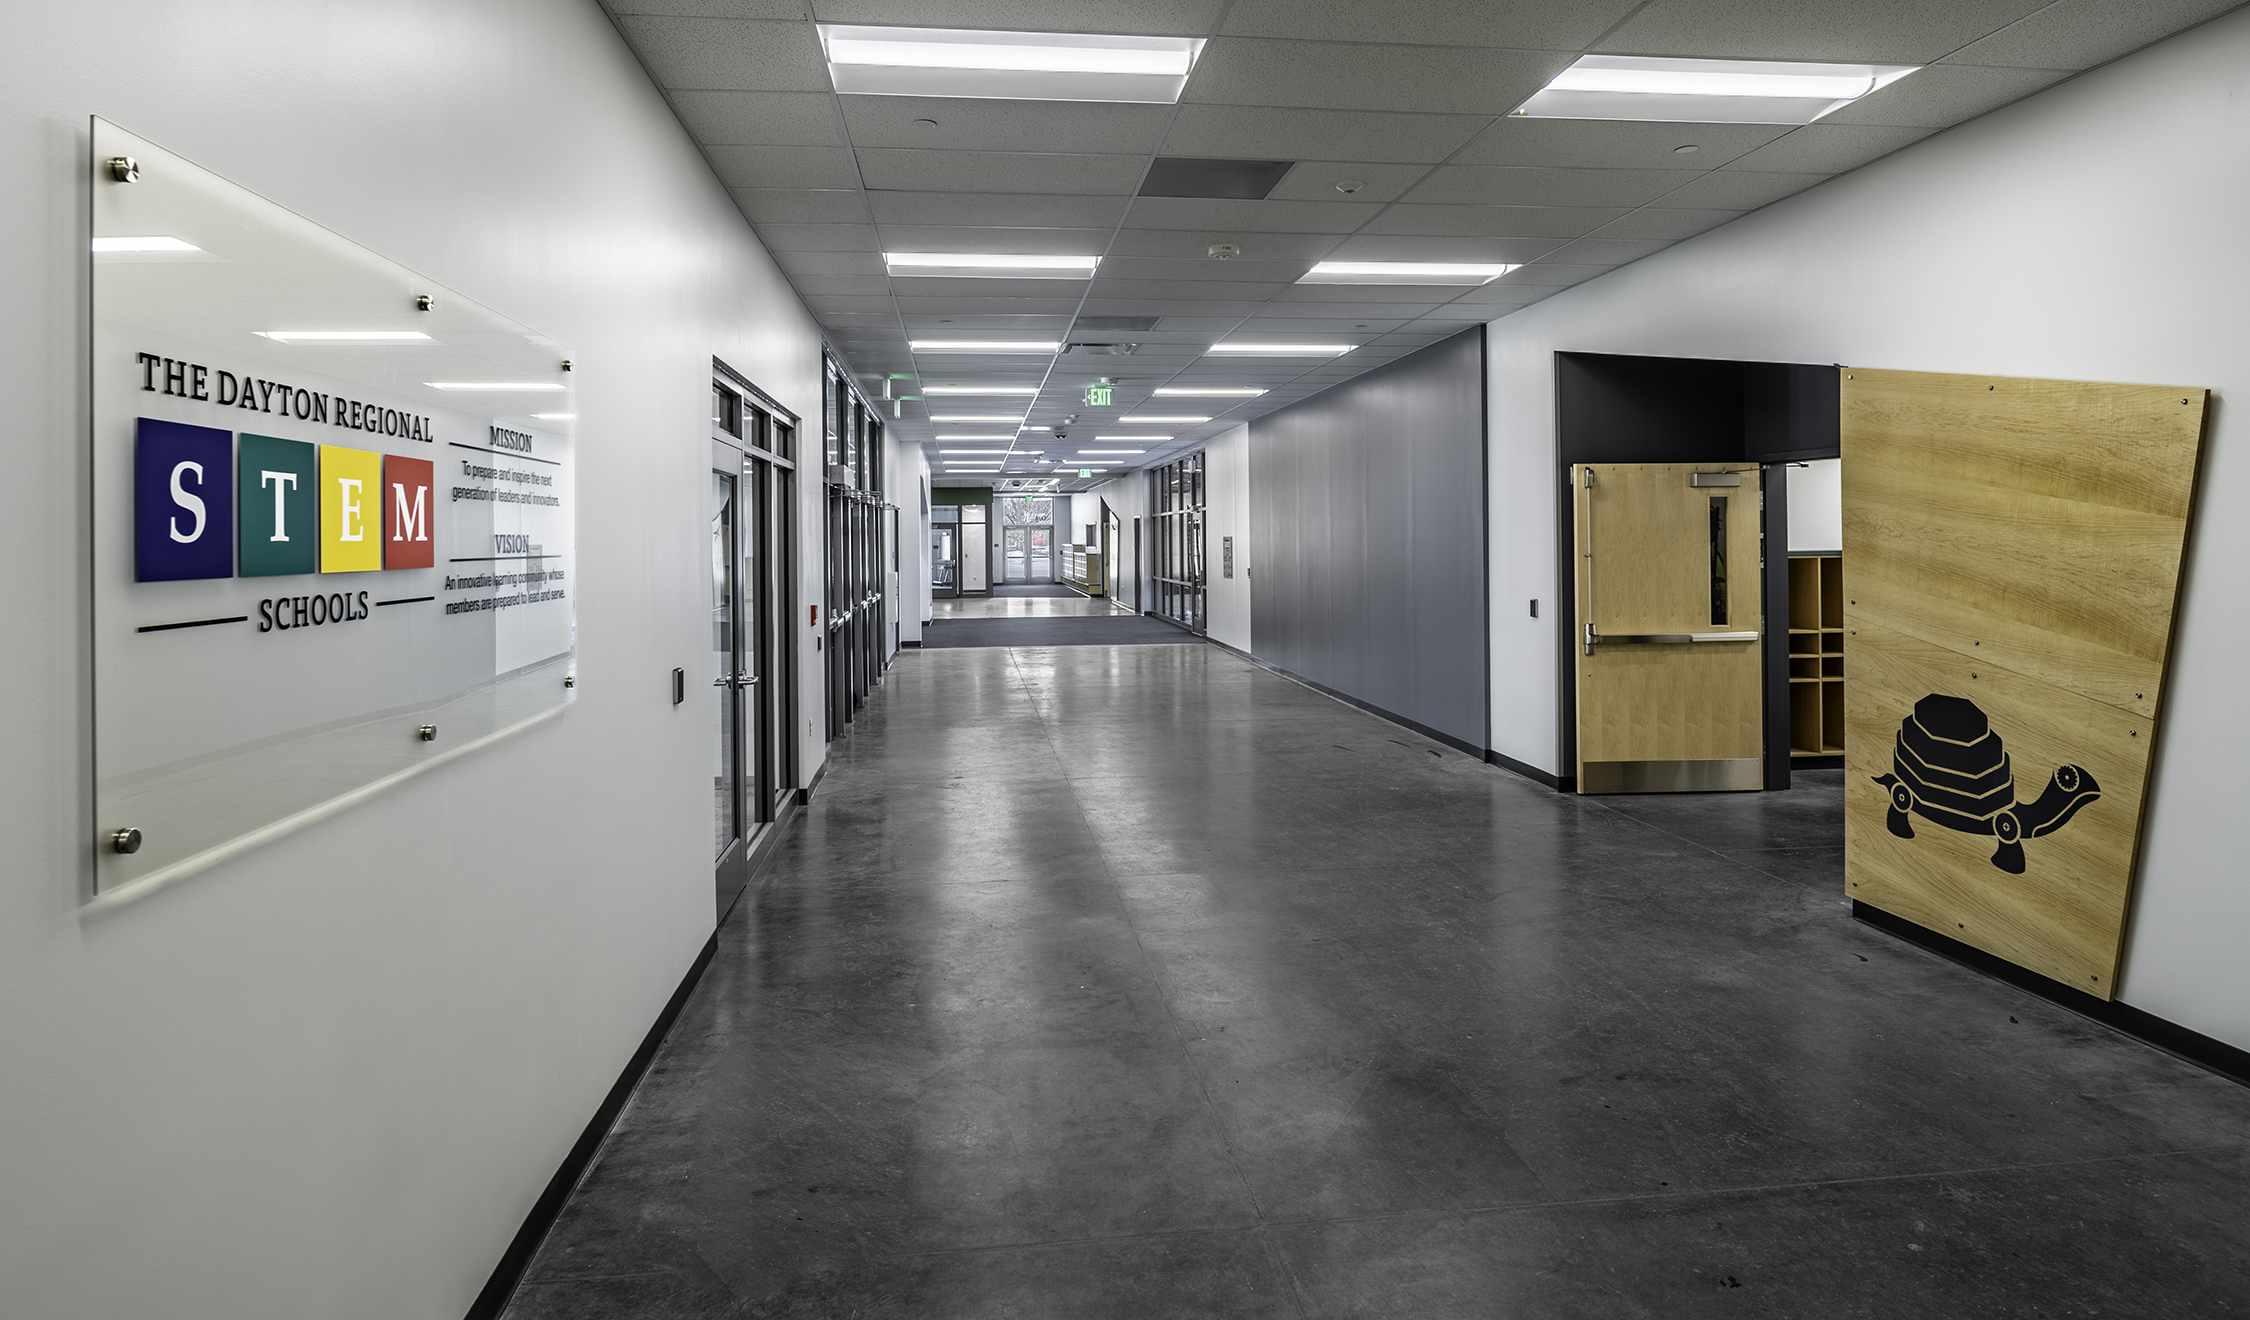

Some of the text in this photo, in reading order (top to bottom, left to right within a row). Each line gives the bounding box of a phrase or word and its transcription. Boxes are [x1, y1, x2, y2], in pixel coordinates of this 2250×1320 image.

[138, 352, 433, 443] THE DAYTON REGIONAL
[1091, 388, 1112, 405] EXIT
[490, 426, 532, 453] MISSION
[462, 460, 552, 486] To prepare and inspire the next
[452, 486, 560, 507] generation of leaders and innovators.
[495, 534, 529, 553] VISION
[445, 568, 564, 590] An innovative learning community whose
[259, 591, 369, 633] SCHOOLS
[446, 588, 565, 615] members are prepared to lead and serve.
